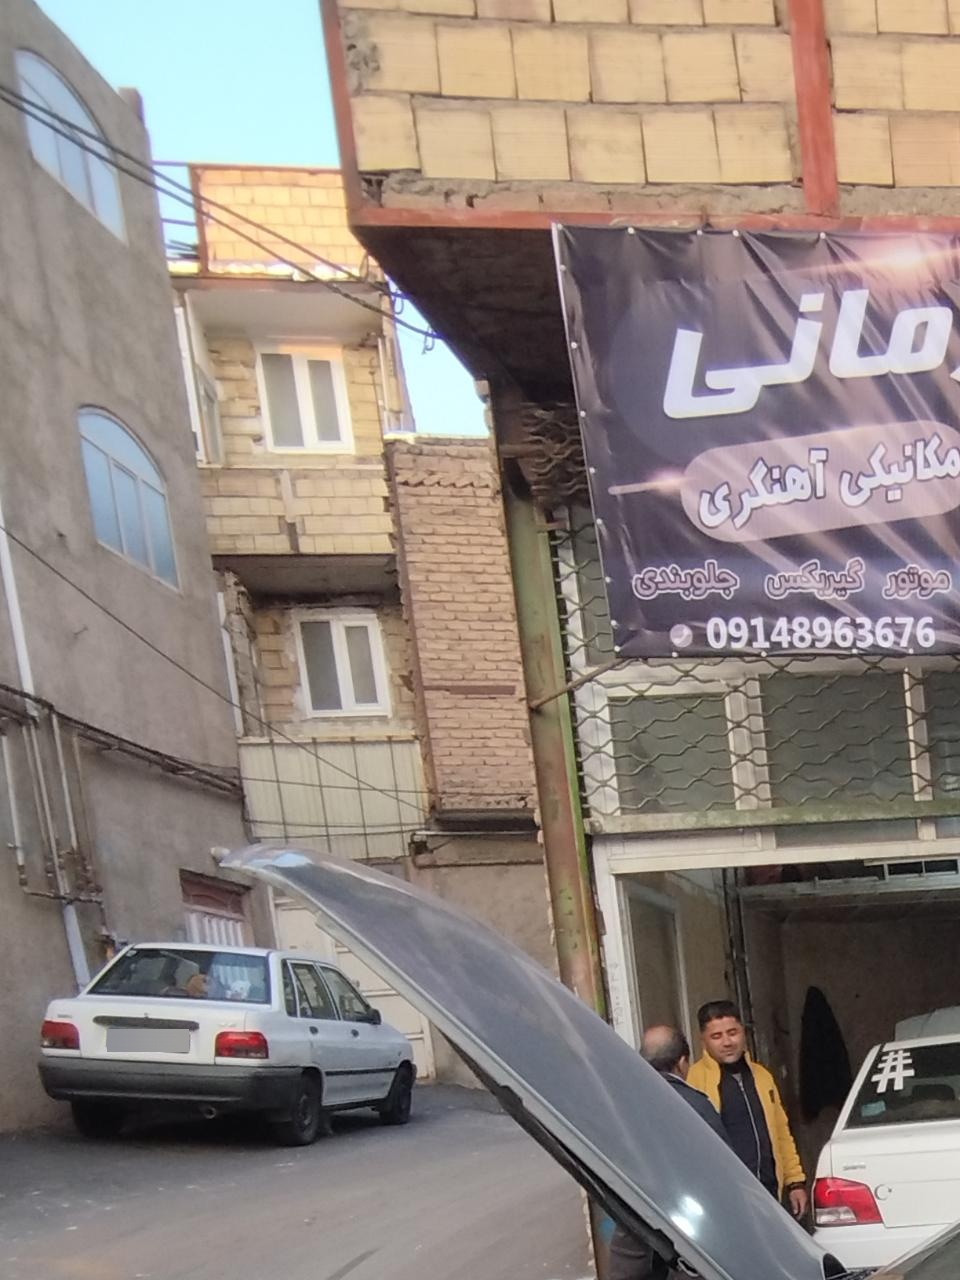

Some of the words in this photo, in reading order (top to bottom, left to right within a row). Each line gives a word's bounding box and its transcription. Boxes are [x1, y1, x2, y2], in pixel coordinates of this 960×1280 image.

[699, 447, 829, 529] آهنگری
[632, 559, 740, 601] جلوبندی
[764, 556, 865, 601] گیربکس
[882, 564, 952, 600] موتور
[705, 616, 937, 649] 09148963676
